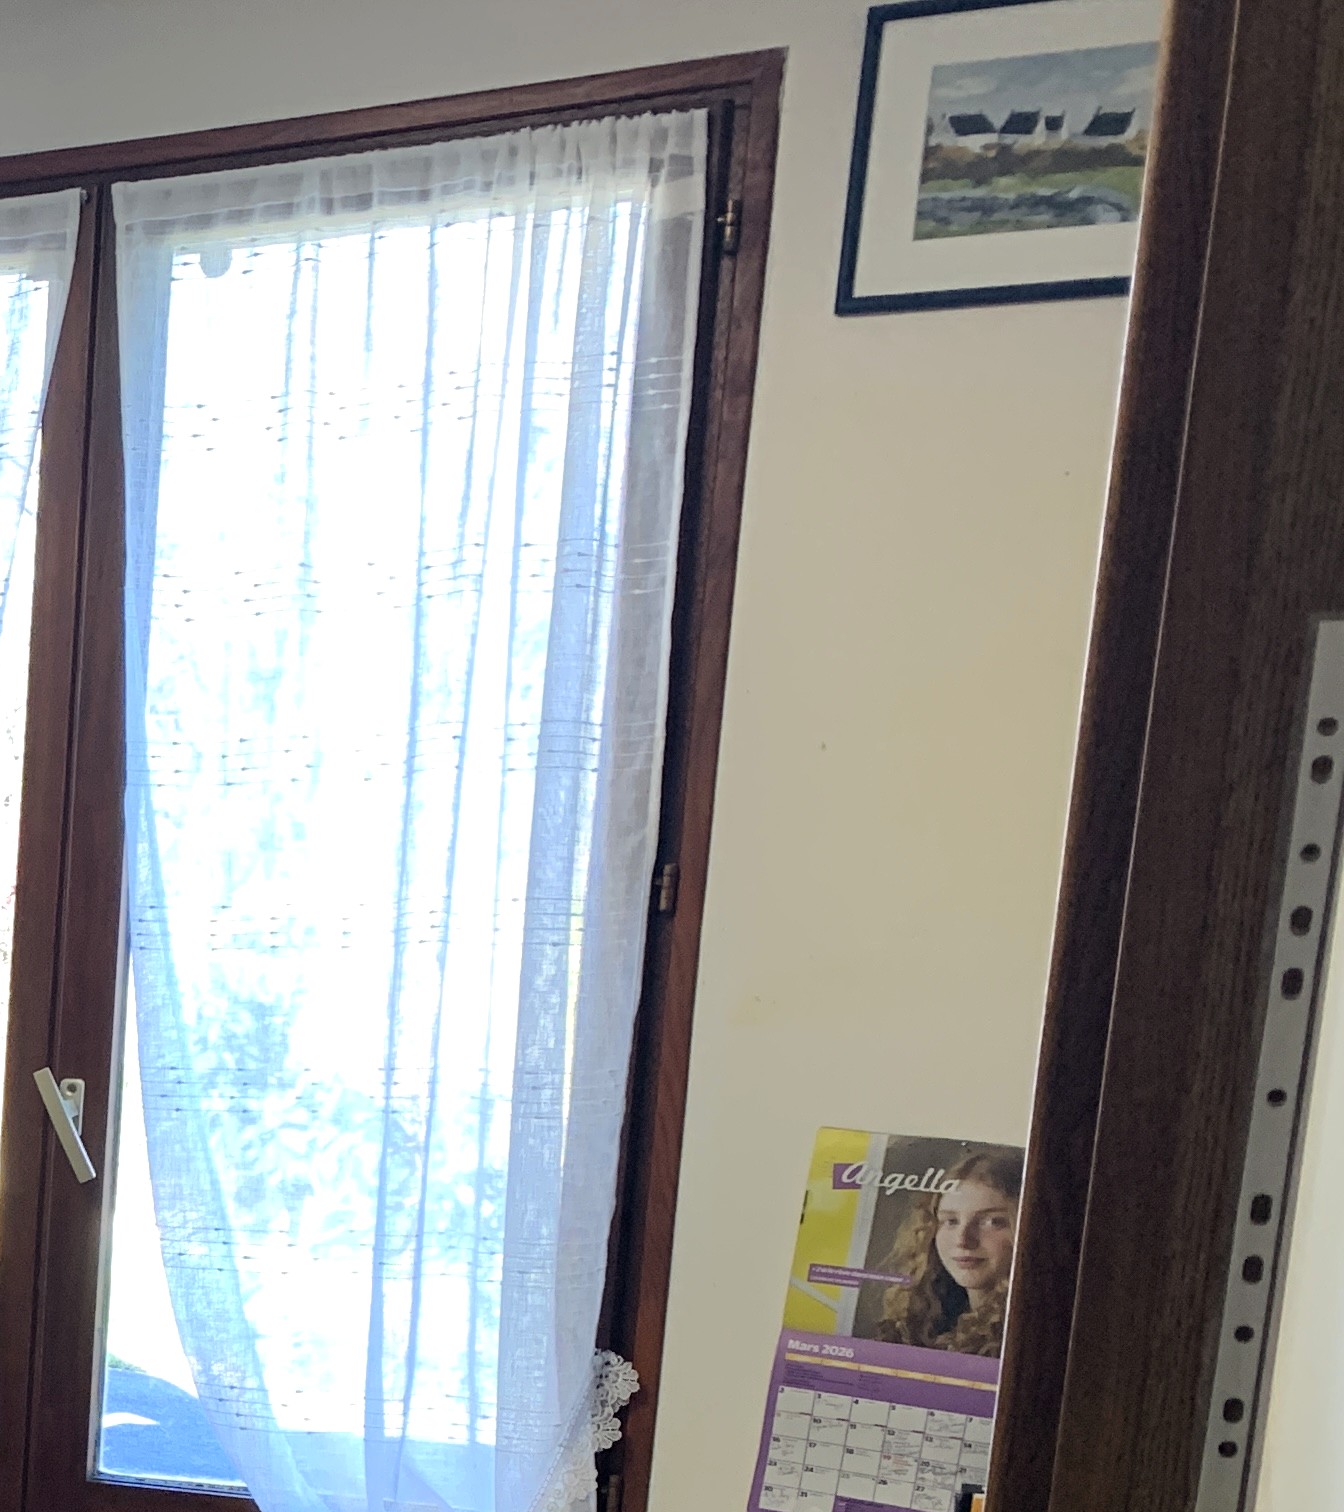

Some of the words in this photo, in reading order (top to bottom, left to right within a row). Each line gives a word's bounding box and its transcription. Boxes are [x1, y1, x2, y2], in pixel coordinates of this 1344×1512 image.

[842, 1161, 962, 1196] Angella
[787, 1339, 820, 1354] Mars
[823, 1344, 855, 1359] 2026
